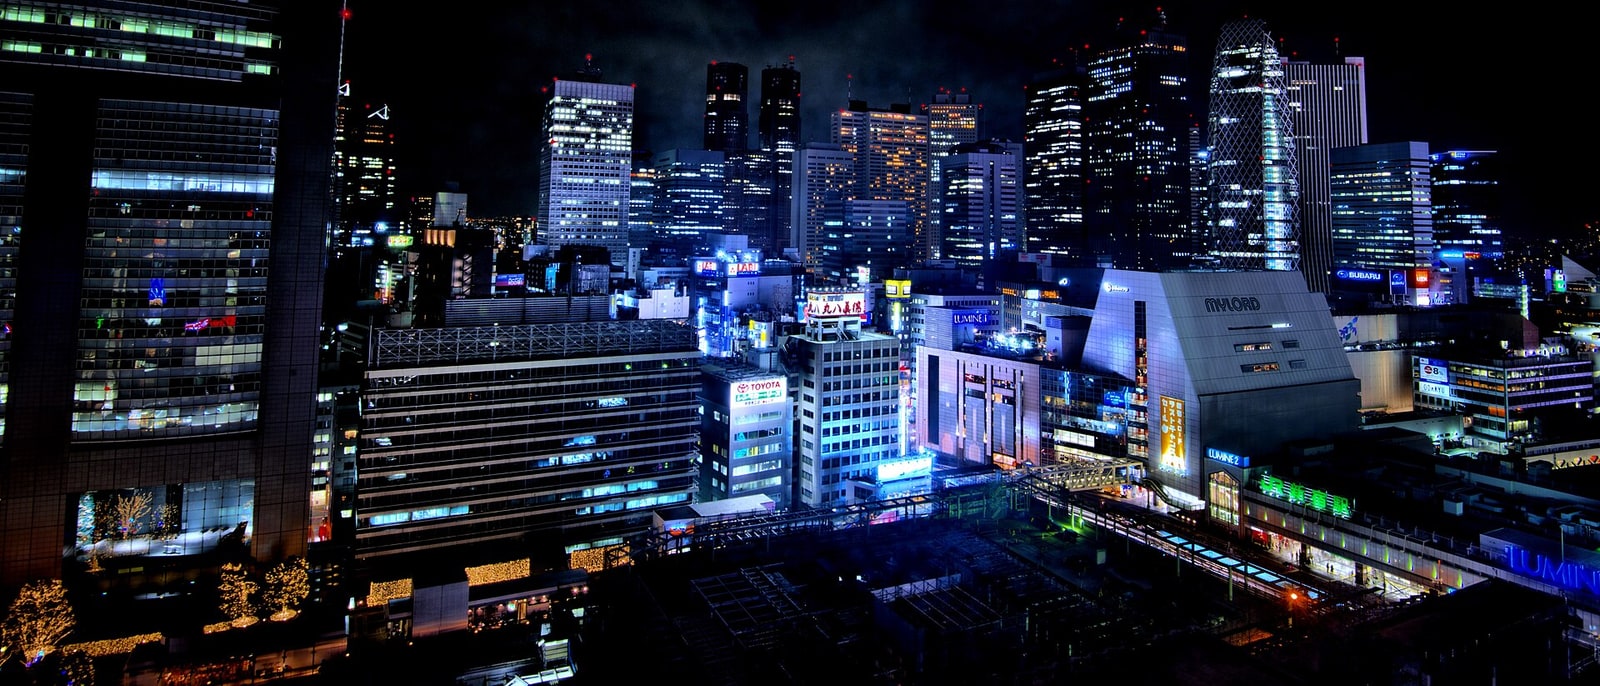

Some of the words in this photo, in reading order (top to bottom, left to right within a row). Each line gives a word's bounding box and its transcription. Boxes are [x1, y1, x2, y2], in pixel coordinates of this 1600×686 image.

[1349, 271, 1381, 280] SUBARU
[1204, 297, 1261, 313] MYLORD
[954, 313, 983, 324] LUMINE
[751, 381, 781, 391] TOYOTA
[1208, 448, 1234, 464] LUMINE
[1234, 455, 1240, 465] 2
[1509, 545, 1600, 594] LUMIN
